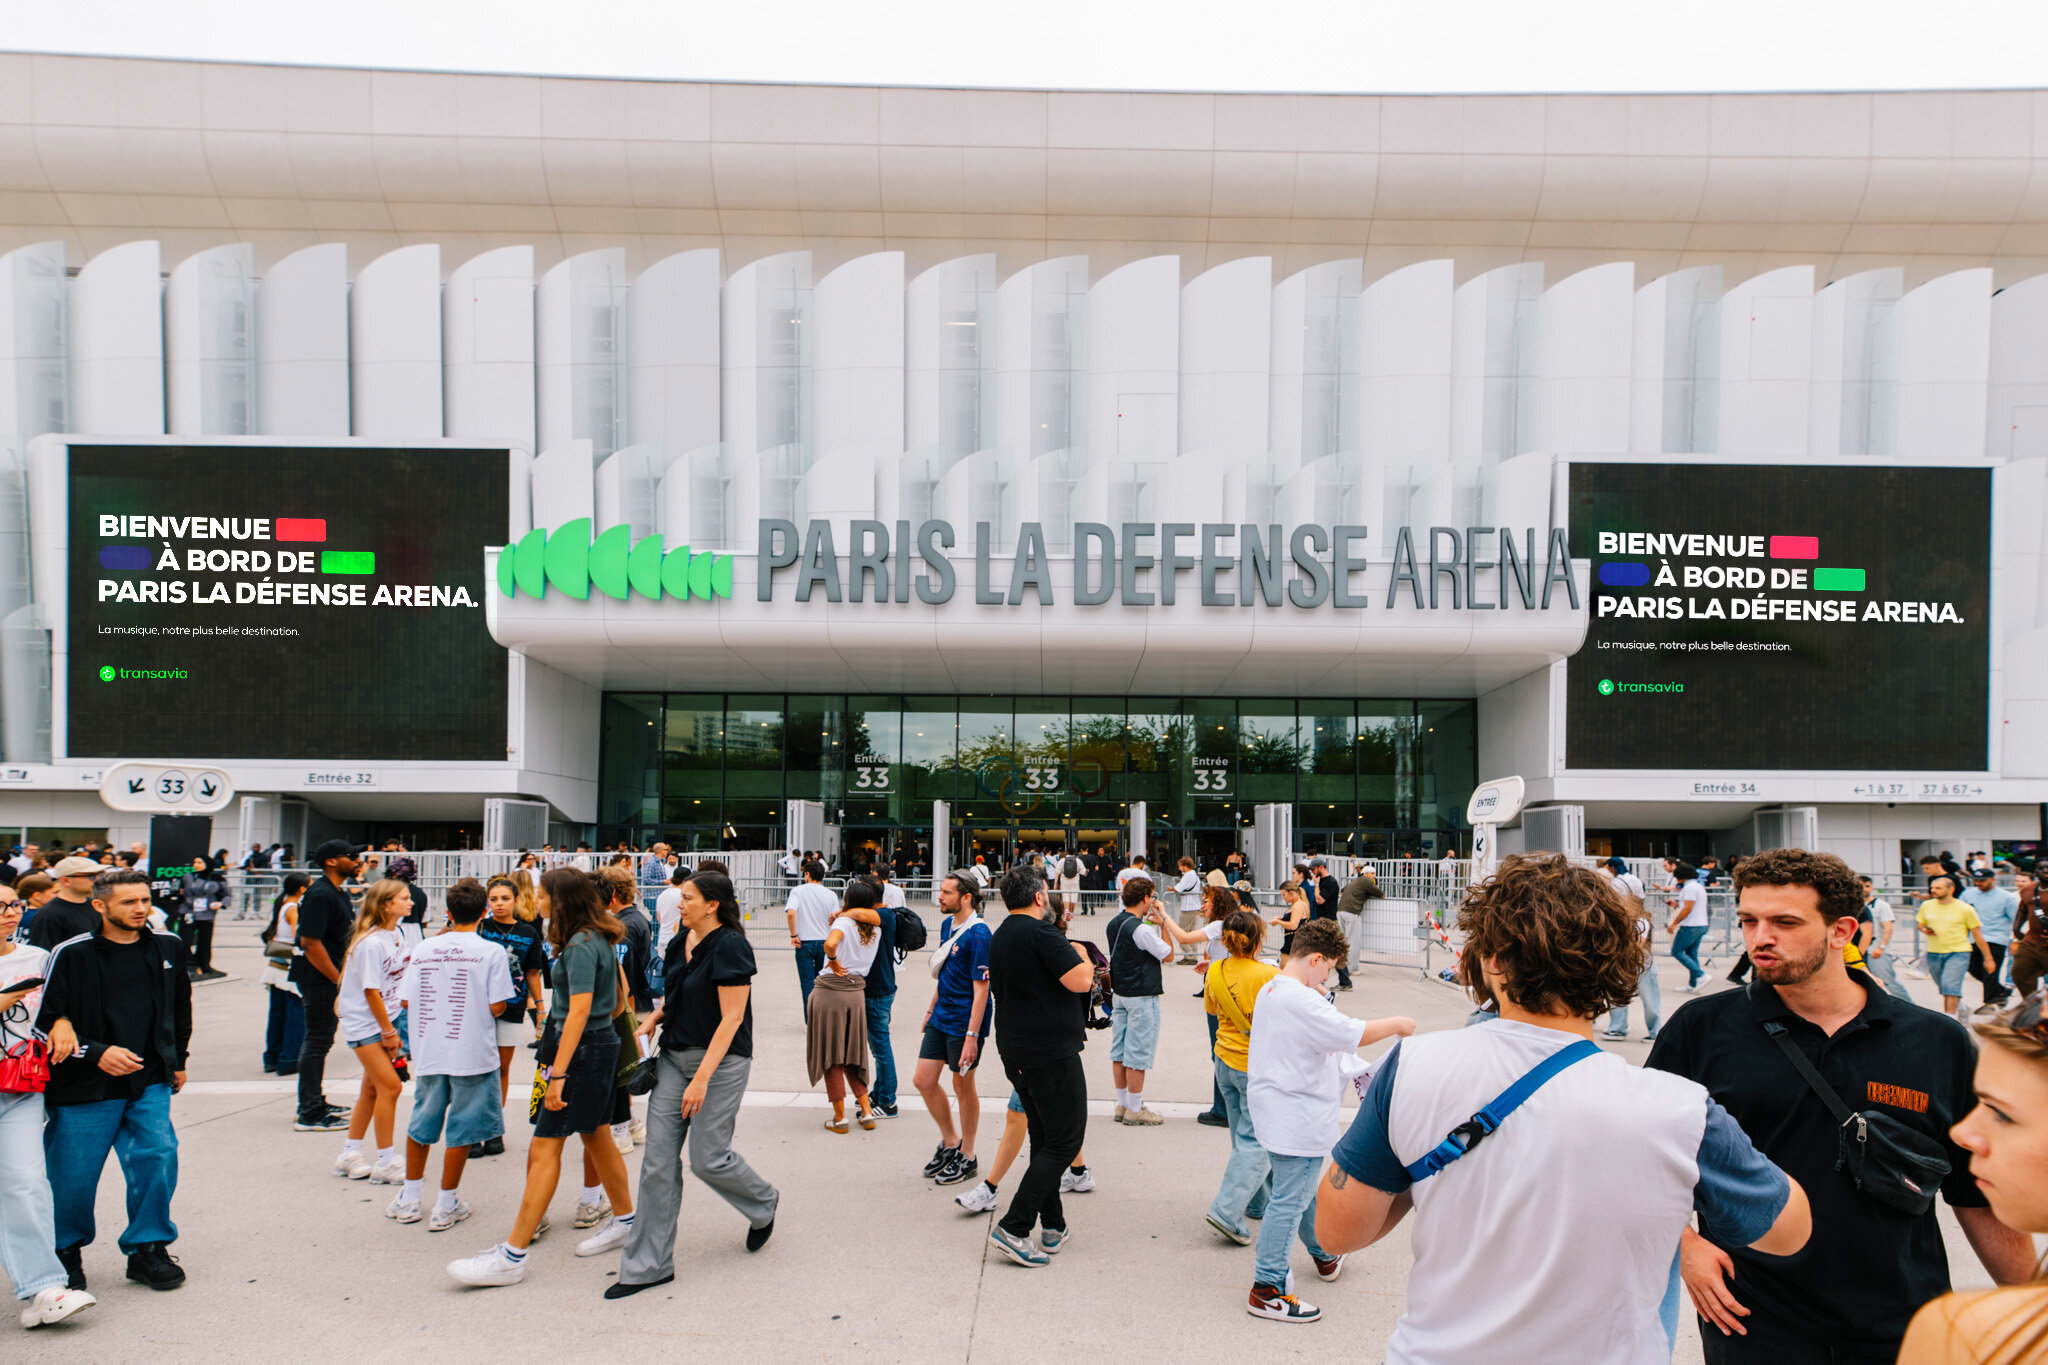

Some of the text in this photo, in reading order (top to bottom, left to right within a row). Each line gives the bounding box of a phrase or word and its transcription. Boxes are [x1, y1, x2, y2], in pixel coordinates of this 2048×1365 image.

[99, 514, 271, 540] BIENVENUE
[1598, 531, 1765, 558] BIENVENUE
[155, 541, 315, 573] À BORD DE
[757, 518, 1581, 610] PARIS LA DEFENSE ARENA
[1653, 559, 1808, 590] À BORD DE
[98, 576, 479, 608] PARIS LA DÉFENSE ARENA.
[1598, 592, 1965, 624] PARIS LA DÉFENSE ARENA.
[98, 624, 300, 638] La musique, notre plus belle destination.
[1597, 639, 1793, 653] La musique, notre plus belle destination.
[119, 667, 188, 680] transavia
[1616, 681, 1684, 694] transavia
[855, 754, 891, 763] Entrée
[1023, 753, 1061, 765] Entrée
[1191, 756, 1229, 766] Entrée
[308, 772, 373, 784] Entrée 32
[855, 767, 890, 789] 33
[1025, 768, 1059, 790] 33
[1193, 769, 1228, 791] 33
[160, 778, 185, 795] 33
[1694, 782, 1756, 793] Entrée 34
[1877, 783, 1885, 794] à
[1889, 784, 1904, 794] 37
[1922, 783, 1969, 794] 37 à 67
[156, 866, 198, 878] FOSS
